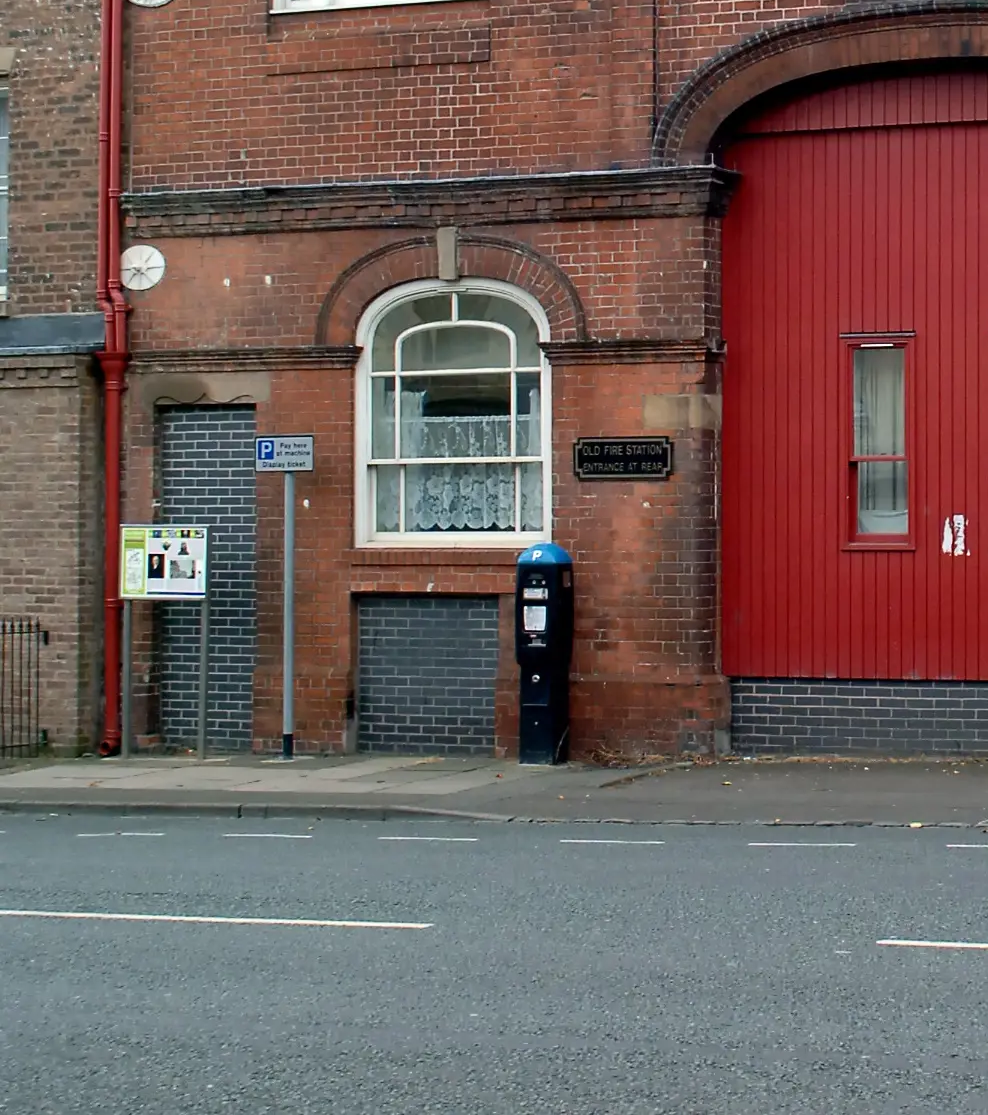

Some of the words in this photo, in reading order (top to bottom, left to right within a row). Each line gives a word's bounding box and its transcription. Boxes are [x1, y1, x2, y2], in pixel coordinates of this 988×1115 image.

[261, 442, 273, 459] P
[582, 445, 601, 456] OLD
[604, 445, 624, 456] FIRE
[626, 444, 663, 456] STATION
[262, 461, 286, 469] Display
[583, 462, 625, 472] ENTRANCE
[627, 462, 639, 472] AT
[641, 462, 663, 472] REAR
[532, 549, 543, 561] P
